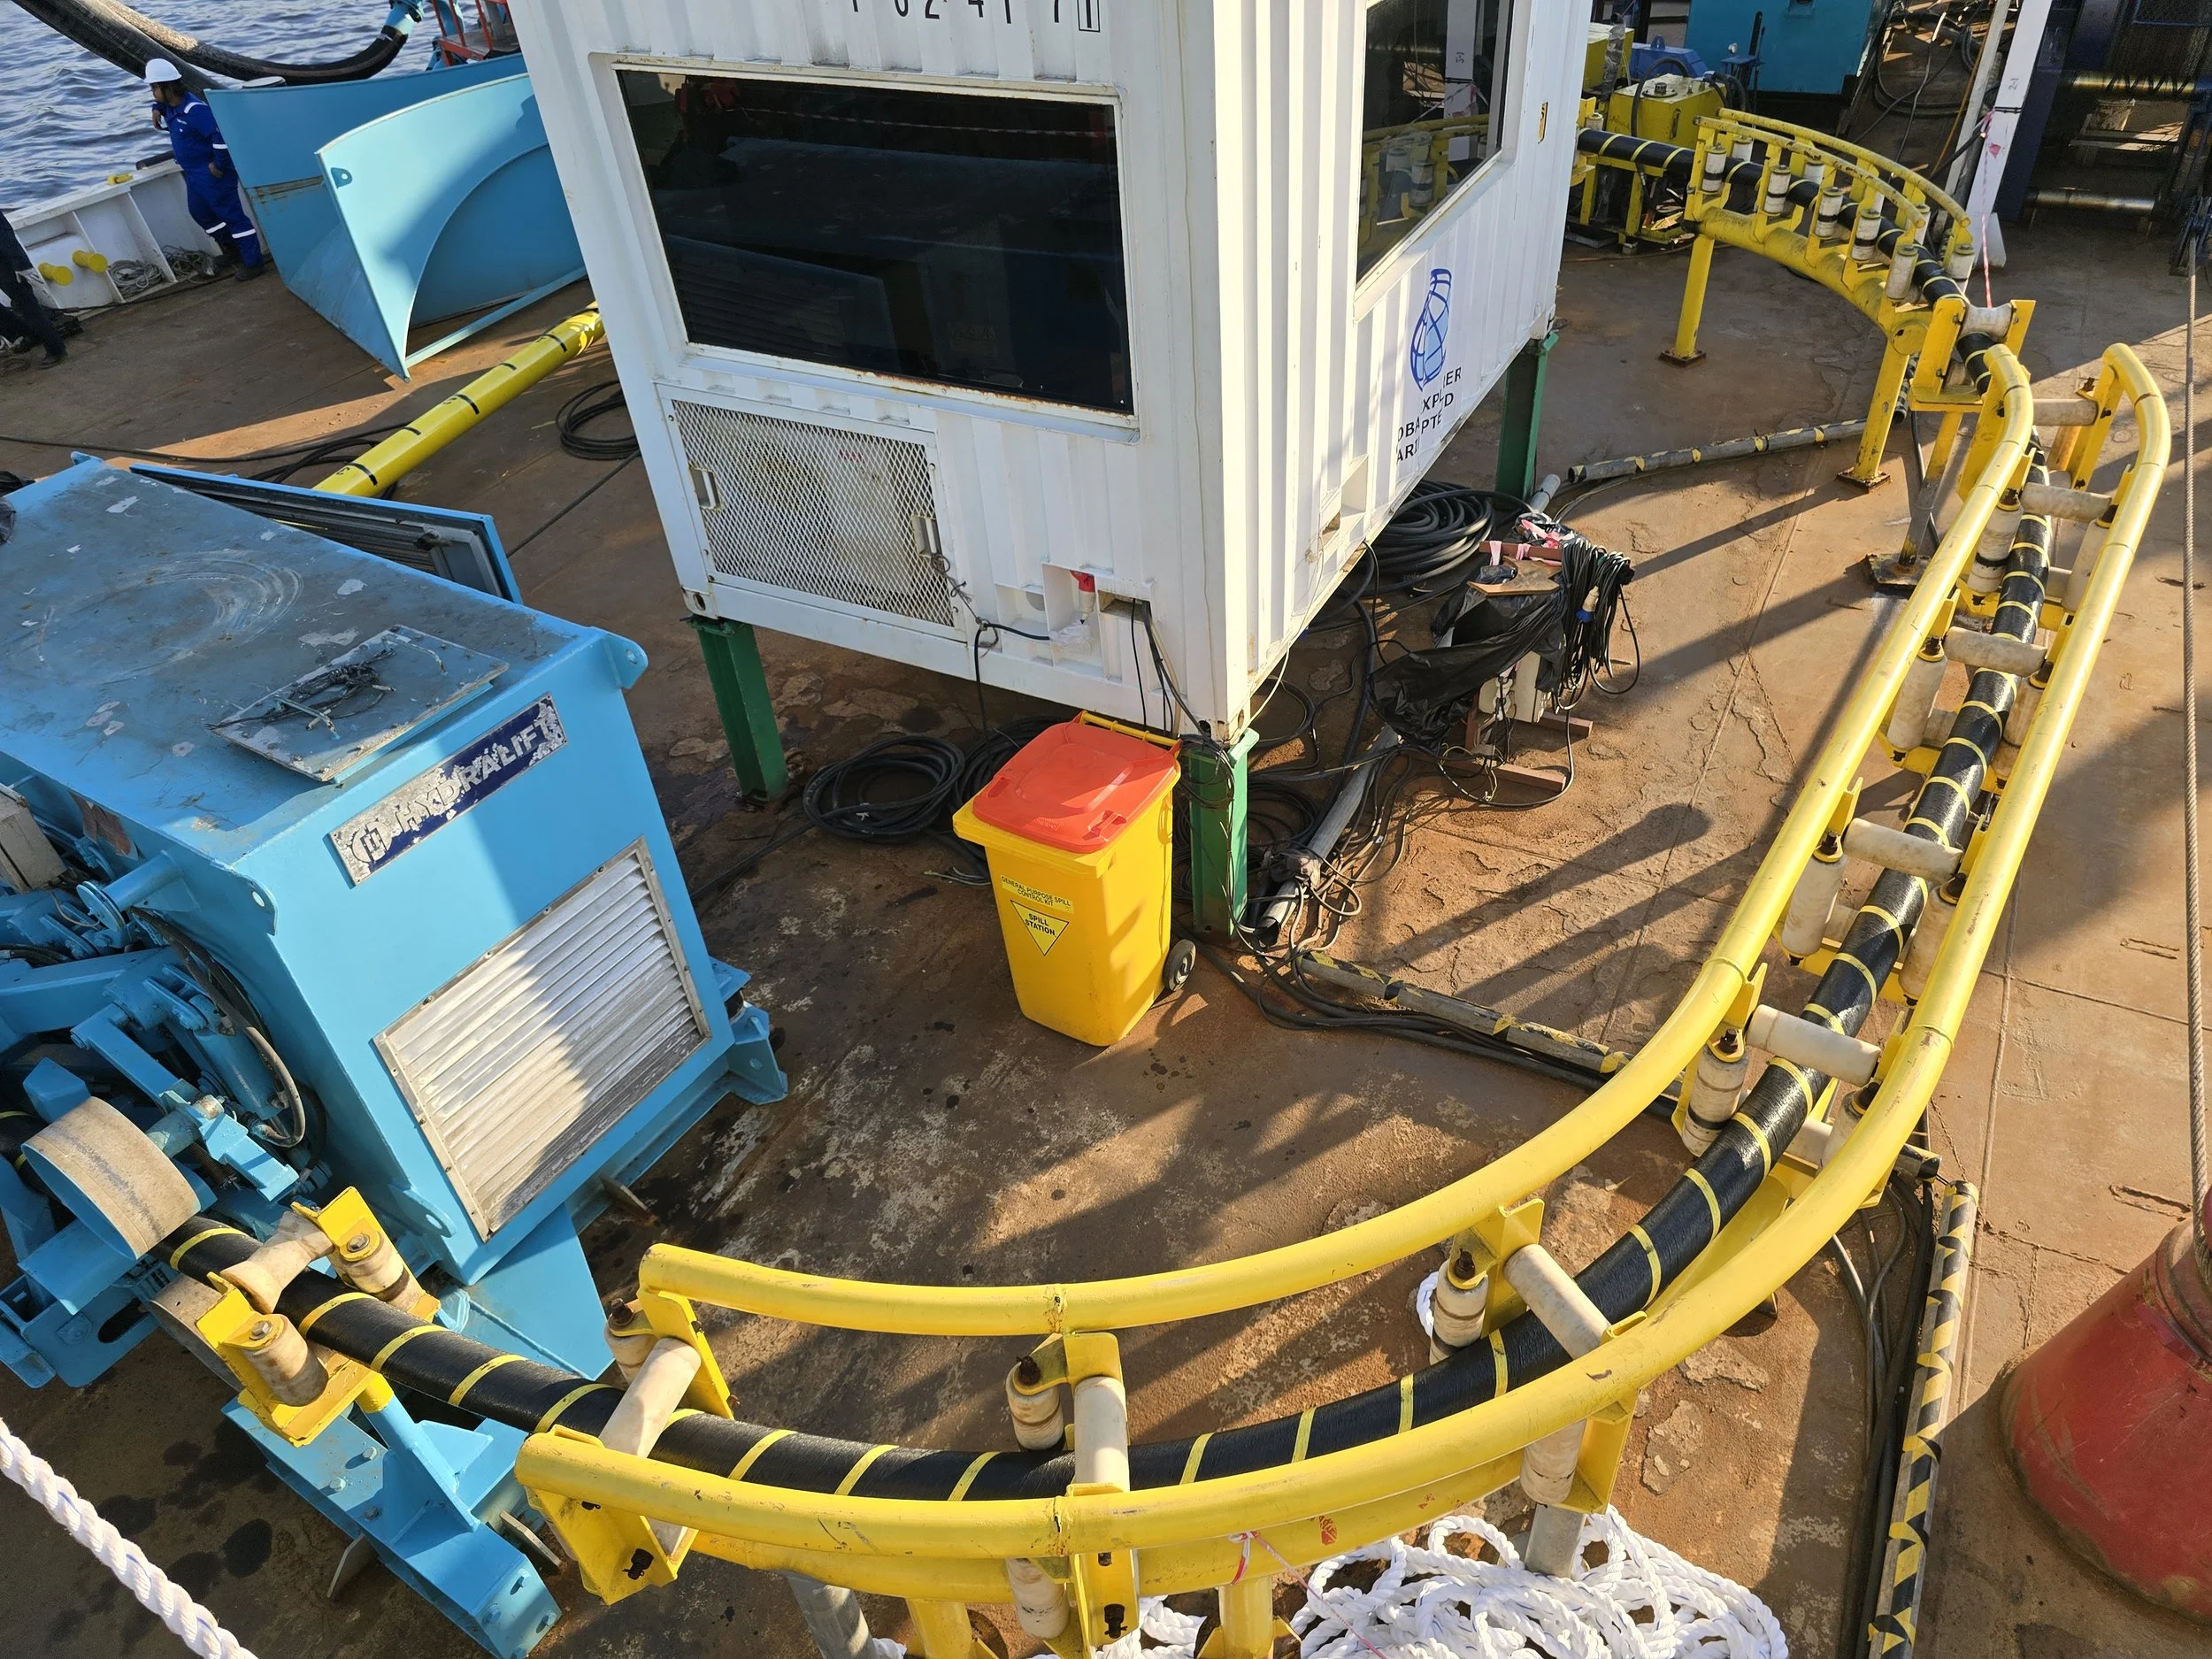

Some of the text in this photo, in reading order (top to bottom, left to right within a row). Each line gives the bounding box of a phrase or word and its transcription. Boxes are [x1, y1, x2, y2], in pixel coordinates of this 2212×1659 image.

[396, 719, 550, 833] HYDRALIFT
[1001, 876, 1071, 907] GENERAL PURPOSE SPILL
[1018, 888, 1044, 902] CONTROL
[1025, 919, 1056, 936] STATION
[1028, 913, 1049, 926] SPILL
